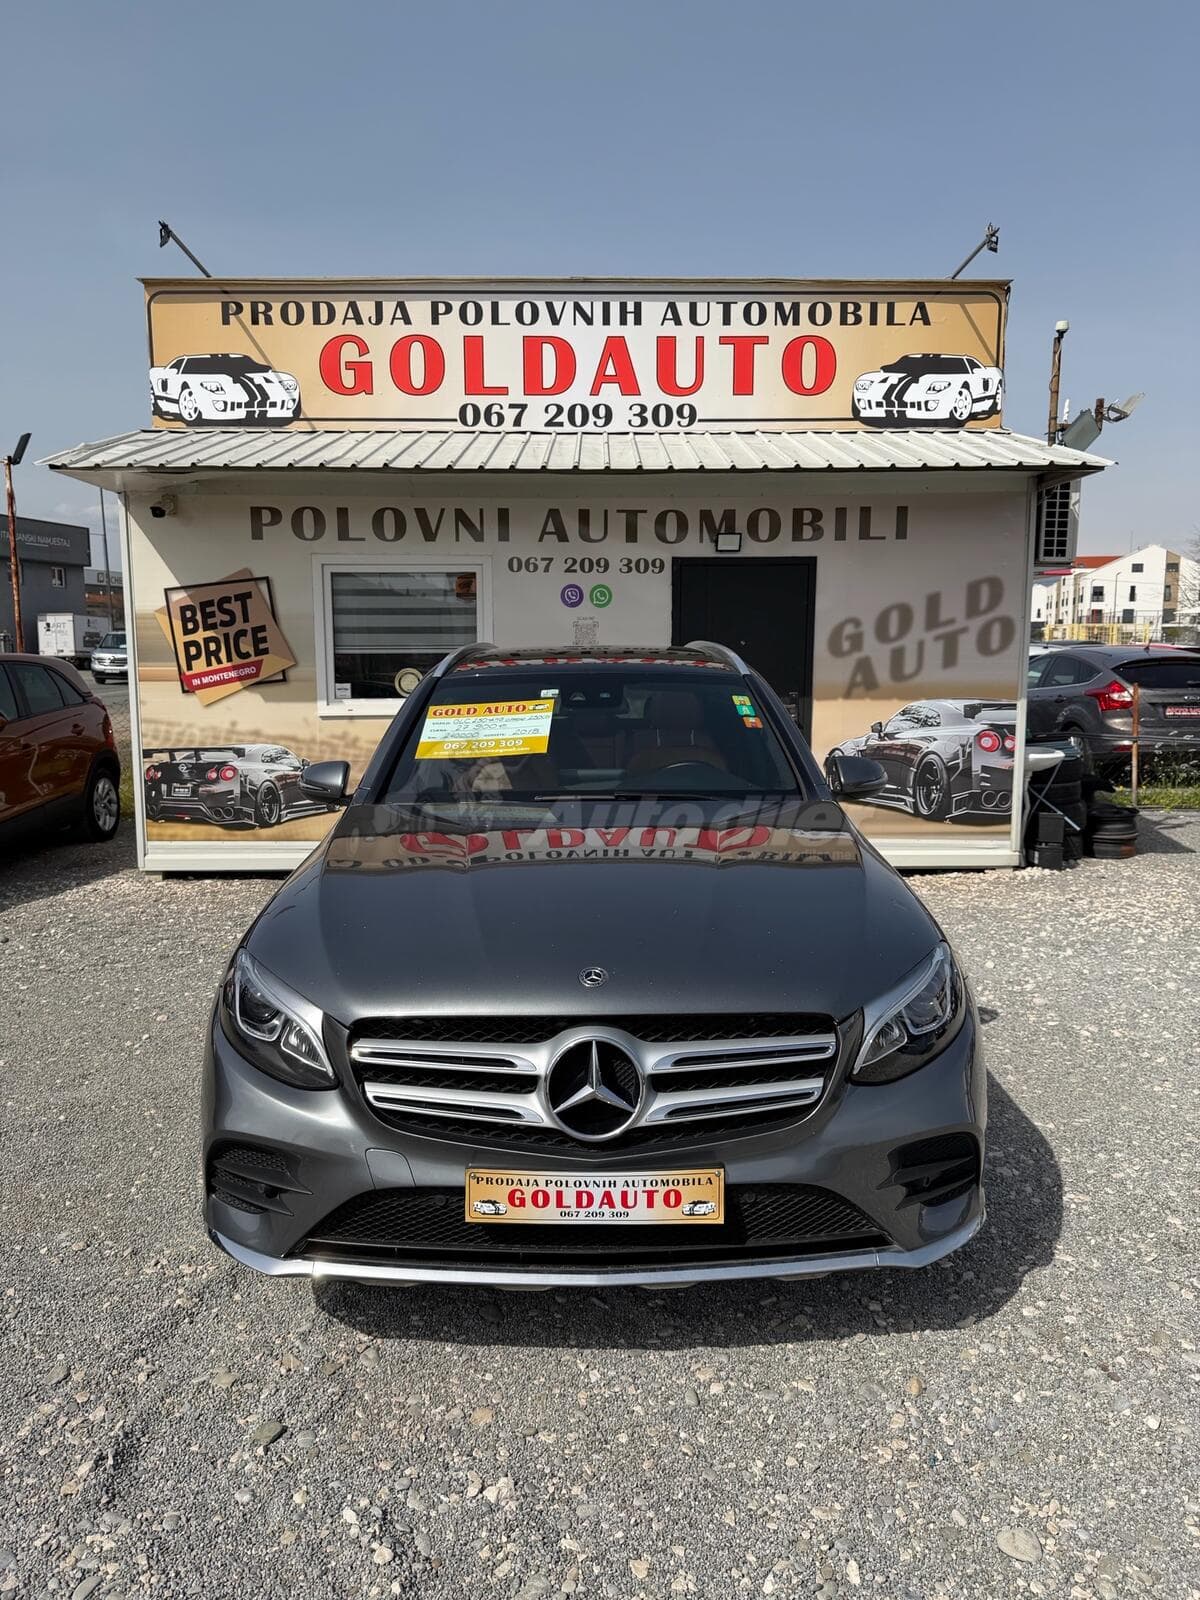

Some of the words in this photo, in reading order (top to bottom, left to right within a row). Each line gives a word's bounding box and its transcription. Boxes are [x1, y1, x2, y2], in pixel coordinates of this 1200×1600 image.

[220, 300, 413, 326] PRODAJA
[430, 300, 643, 326] POLOVNIH
[660, 300, 932, 326] AUTOMOBILA
[319, 334, 837, 396] GOLDAUTO
[458, 402, 529, 428] 067
[543, 403, 613, 428] 209
[627, 403, 698, 428] 309
[250, 506, 511, 543] POLOVNI
[538, 505, 909, 544] AUTOMOBILI
[507, 556, 554, 574] 067
[563, 556, 610, 574] 209
[618, 556, 665, 575] 309
[179, 591, 253, 637] BEST
[827, 575, 1005, 658] GOLD
[183, 625, 270, 671] PRICE
[843, 615, 1016, 700] AUTO
[191, 677, 201, 686] IN
[202, 666, 257, 684] MONTENEGRO
[432, 707, 478, 717] GOLD
[482, 704, 527, 715] AUTO
[443, 741, 468, 750] 067
[471, 740, 496, 749] 209
[499, 738, 524, 748] 309
[476, 1176, 540, 1188] PRODAJA
[545, 1178, 618, 1189] POLOVNIH
[622, 1176, 714, 1189] AUTOMOBILA
[507, 1188, 683, 1210] GOLDAUTO
[559, 1210, 580, 1219] 067
[582, 1211, 605, 1219] 209
[608, 1210, 630, 1219] 309
